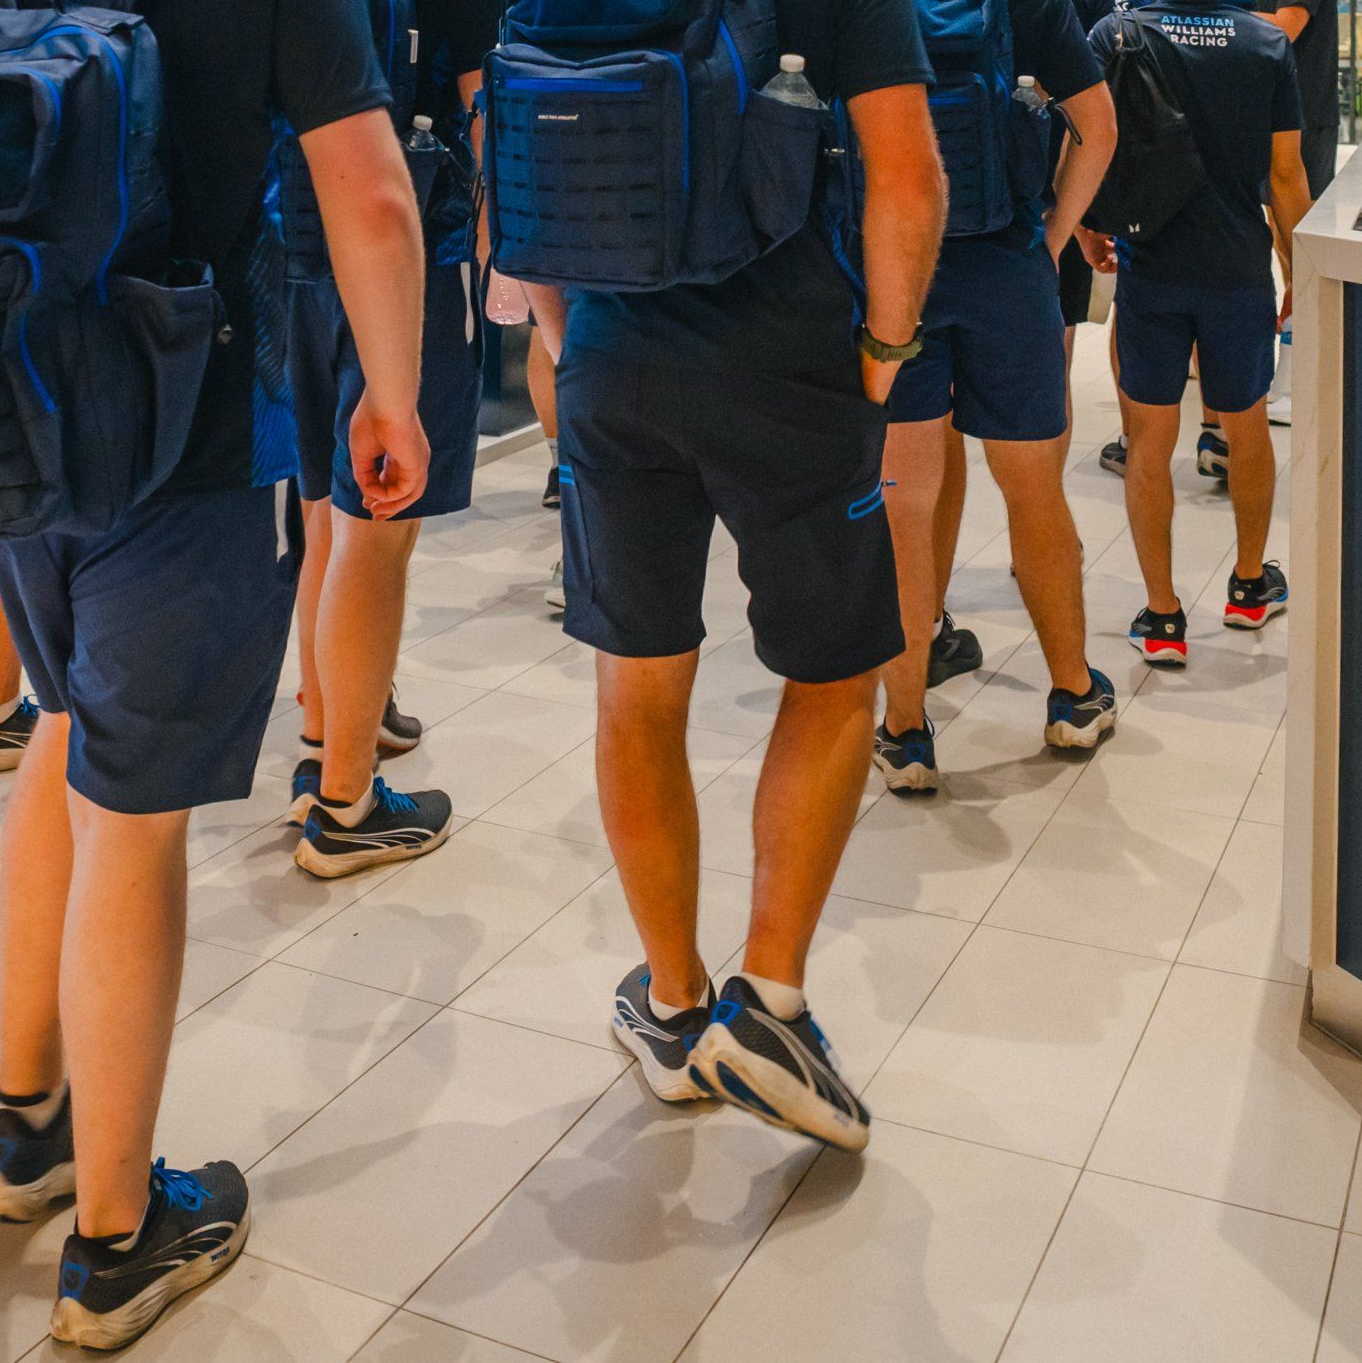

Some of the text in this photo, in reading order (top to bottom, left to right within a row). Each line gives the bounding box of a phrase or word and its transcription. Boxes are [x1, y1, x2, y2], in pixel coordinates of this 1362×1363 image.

[1161, 15, 1234, 26] ATLASSIAN
[1161, 25, 1236, 36] WILLIAMS
[1170, 35, 1228, 47] RACING
